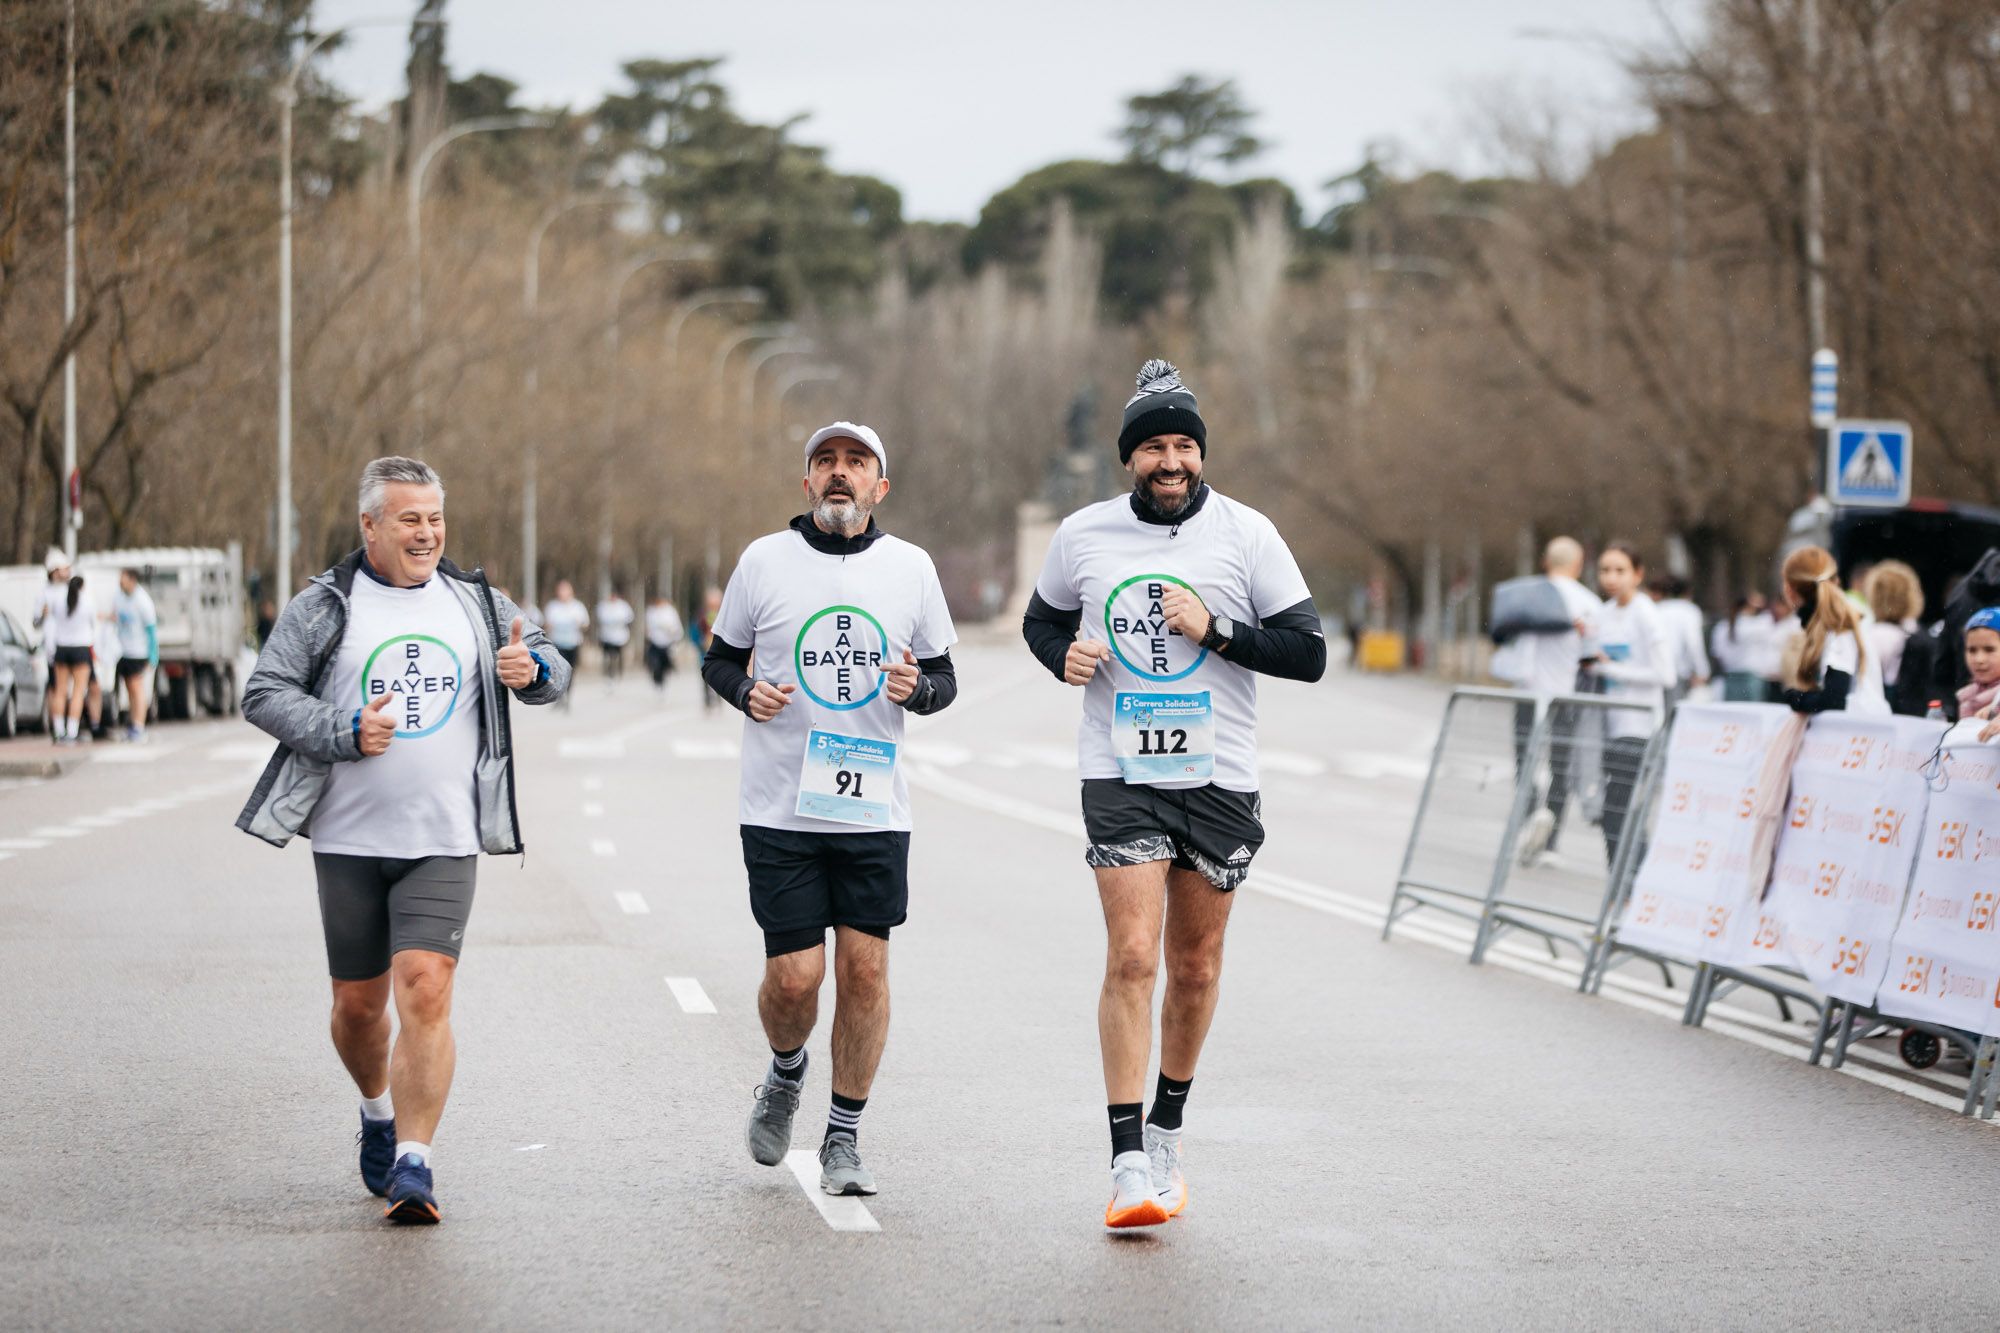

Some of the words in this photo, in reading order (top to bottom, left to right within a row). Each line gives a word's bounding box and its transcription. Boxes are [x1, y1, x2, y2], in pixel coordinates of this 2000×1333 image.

[1113, 617, 1183, 636] BAY
[1147, 583, 1169, 673] BAYER
[803, 650, 882, 667] BAYER
[835, 615, 851, 702] BAYER
[371, 676, 456, 694] BAYER
[405, 644, 421, 729] BAYER
[1133, 699, 1163, 707] Carrera
[1165, 700, 1199, 708] Solidaria
[829, 740, 856, 751] Carrera
[857, 744, 884, 755] Solidaria
[1139, 729, 1187, 755] 112
[836, 770, 862, 798] 91
